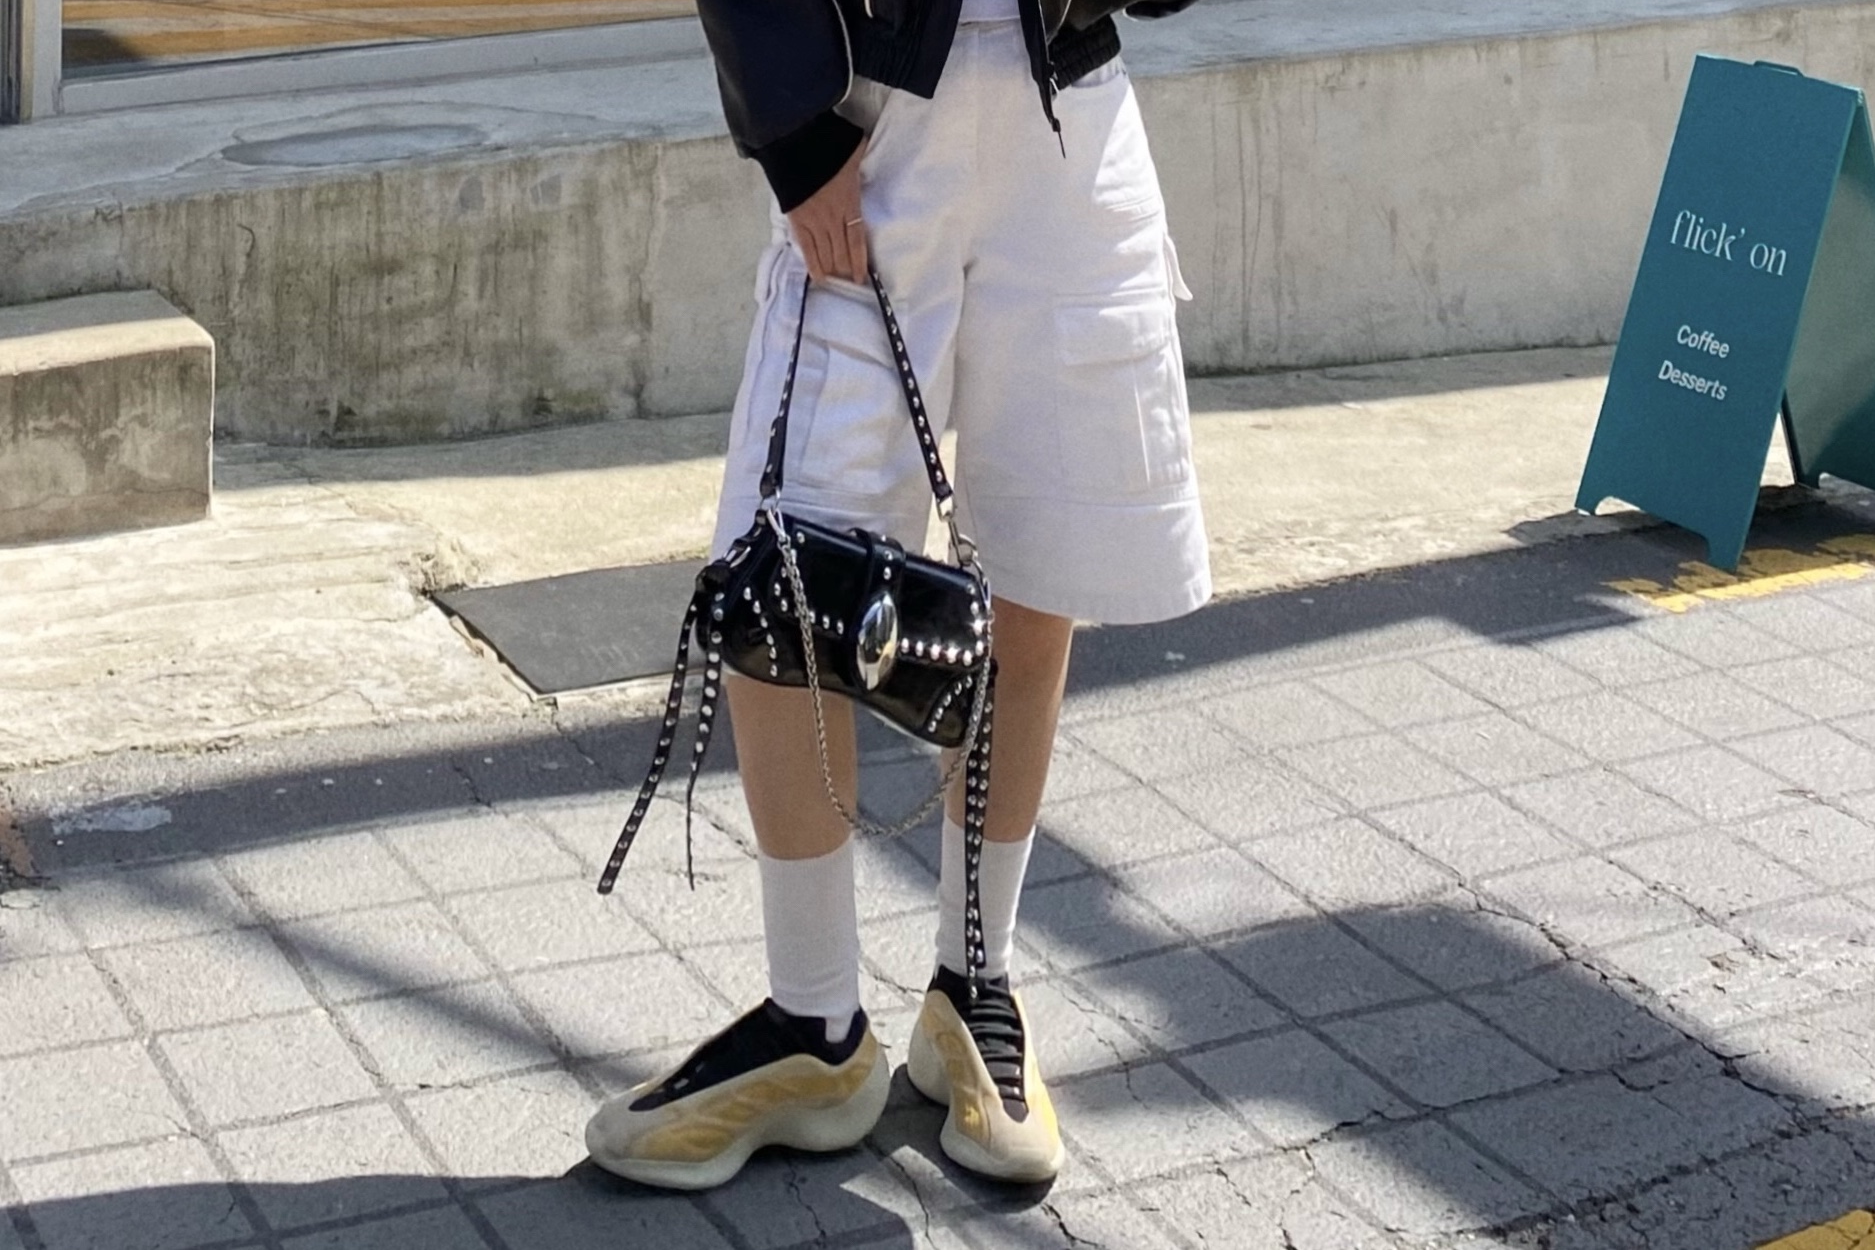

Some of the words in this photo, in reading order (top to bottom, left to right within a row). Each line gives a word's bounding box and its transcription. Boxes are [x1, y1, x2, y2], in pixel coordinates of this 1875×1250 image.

[1670, 209, 1746, 261] flick'
[1749, 242, 1787, 277] on
[1676, 323, 1731, 359] Coffee
[1658, 358, 1728, 402] Desserts
